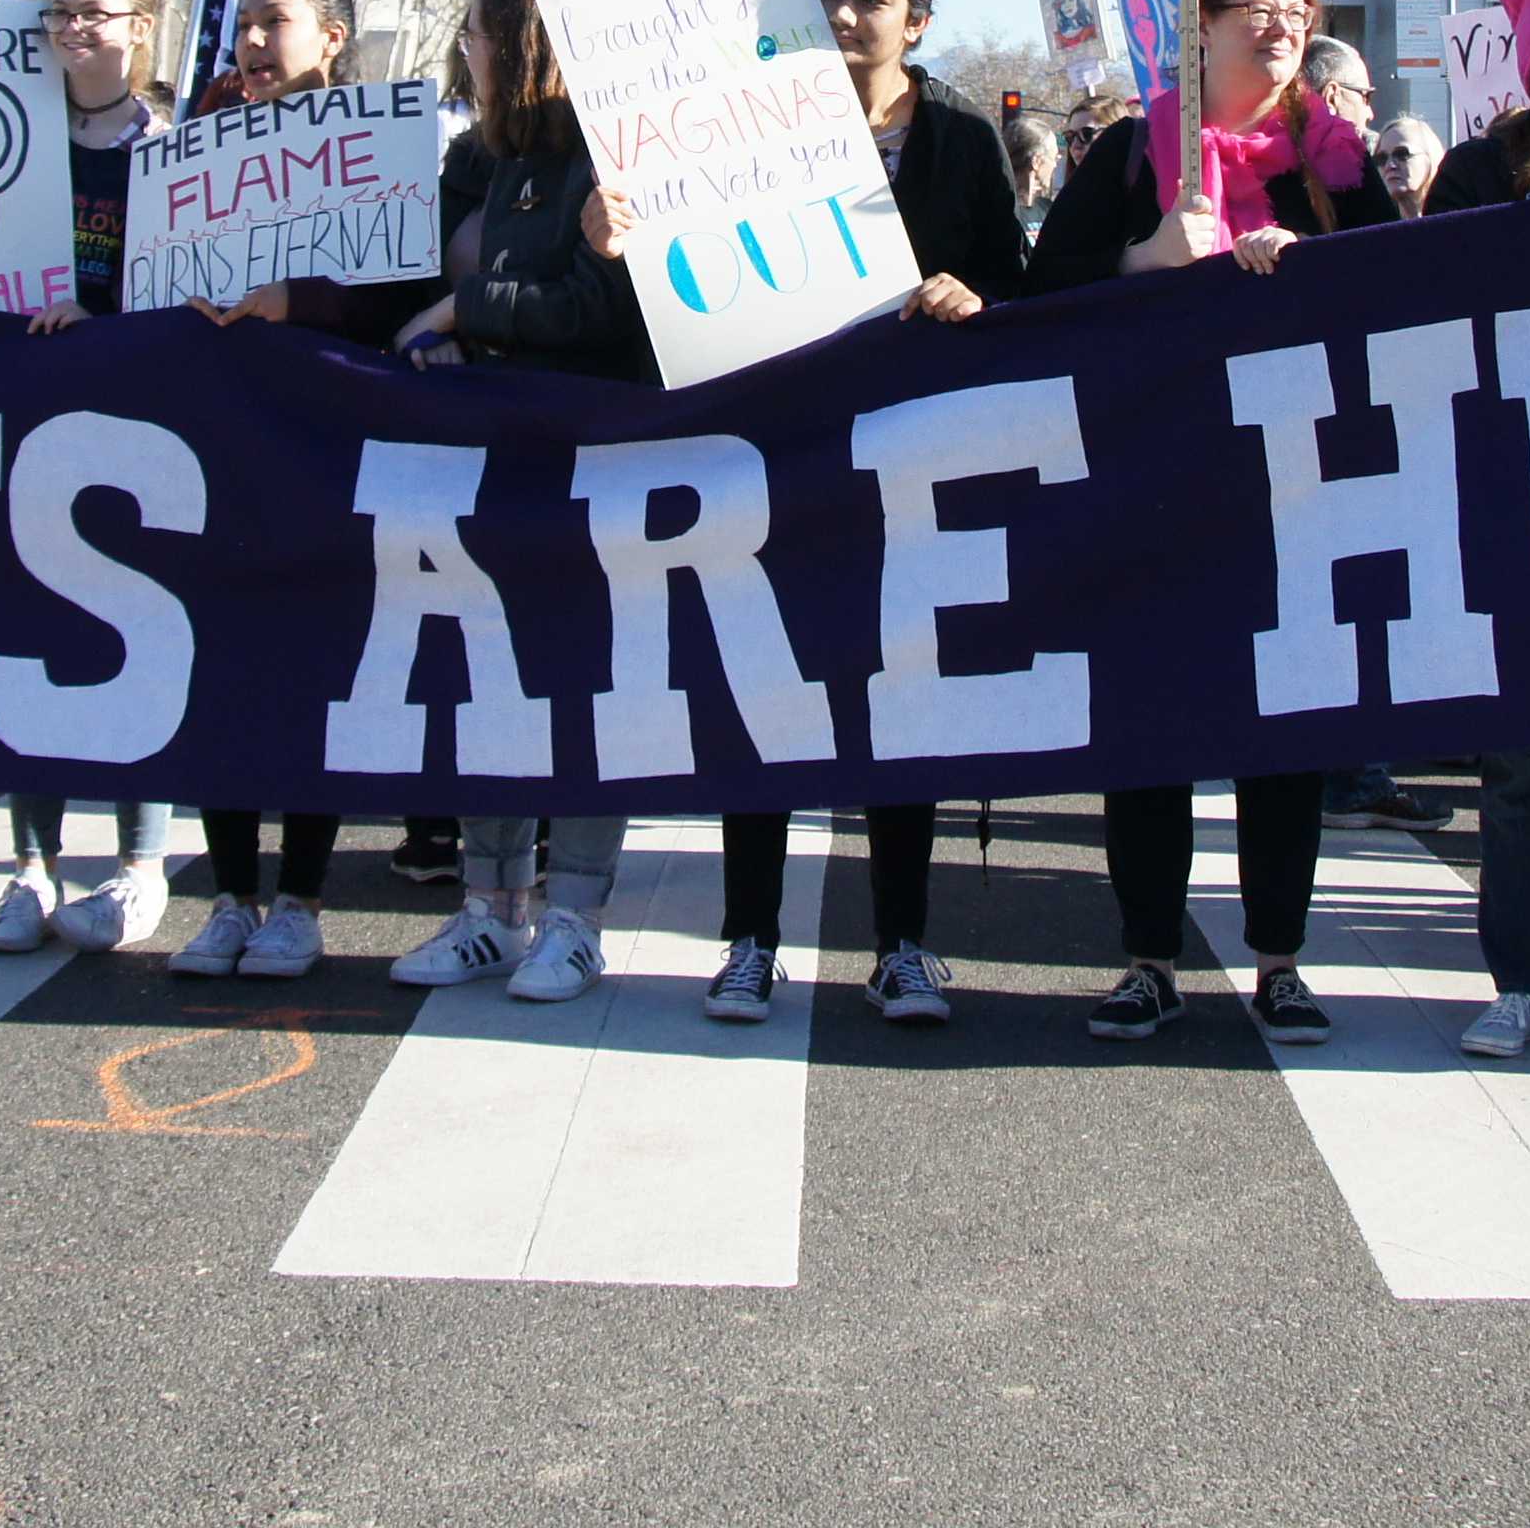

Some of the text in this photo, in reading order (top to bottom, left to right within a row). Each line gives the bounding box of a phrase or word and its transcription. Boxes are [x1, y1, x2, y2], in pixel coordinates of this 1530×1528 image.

[134, 80, 424, 176] THE FEMALE
[582, 80, 639, 112] into
[650, 56, 707, 92] this
[589, 69, 852, 172] VAGINAS
[167, 131, 381, 232] FLAME
[790, 138, 852, 183] you
[130, 200, 422, 312] BURNS ETERNAL
[666, 184, 869, 315] OUT
[324, 374, 1091, 782] ARE
